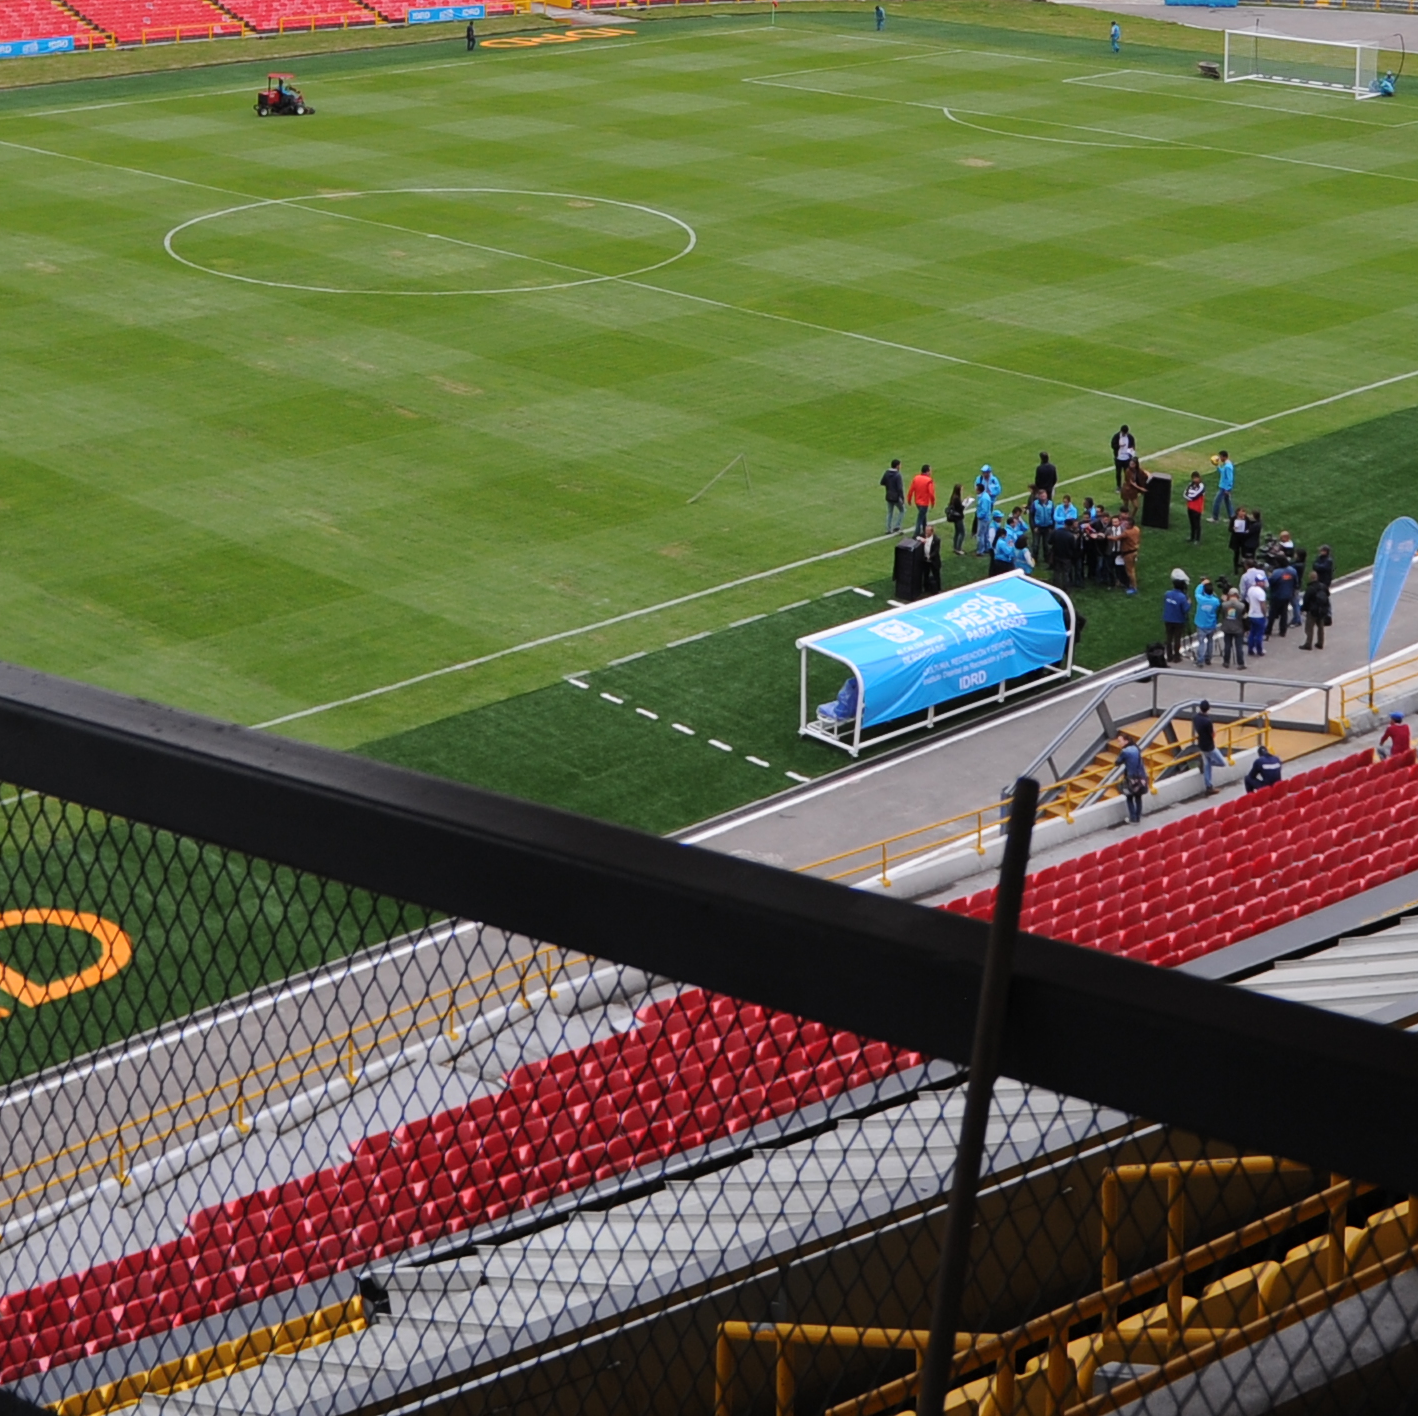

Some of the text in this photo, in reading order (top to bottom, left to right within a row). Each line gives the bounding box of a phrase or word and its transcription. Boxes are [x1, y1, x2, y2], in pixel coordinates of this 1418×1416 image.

[951, 602, 1023, 630] MEJOR
[965, 624, 995, 642] PARA
[959, 670, 987, 690] IDRD
